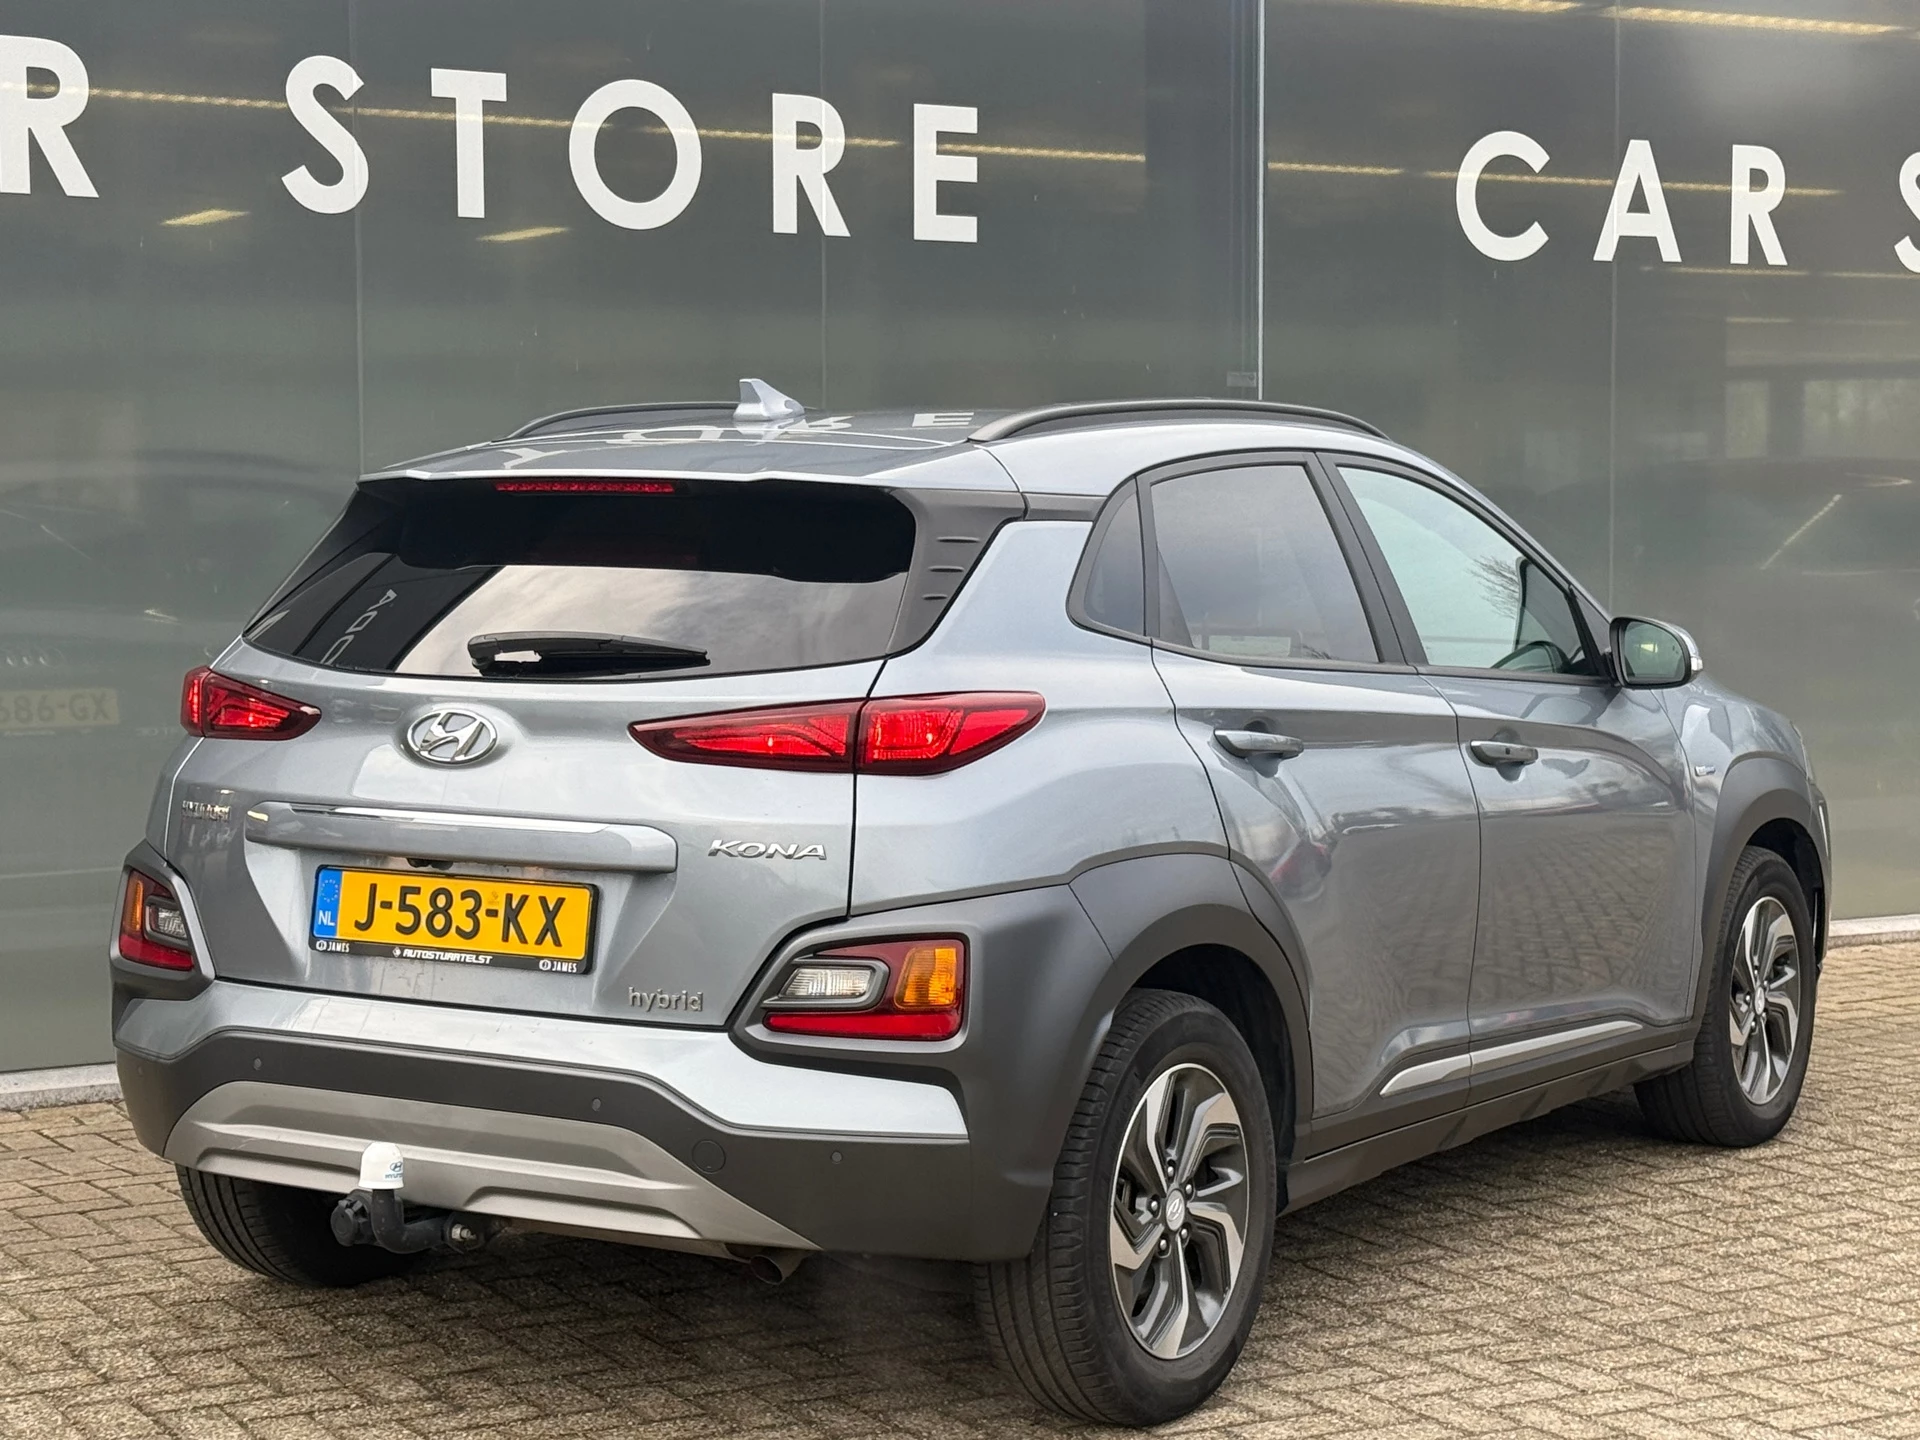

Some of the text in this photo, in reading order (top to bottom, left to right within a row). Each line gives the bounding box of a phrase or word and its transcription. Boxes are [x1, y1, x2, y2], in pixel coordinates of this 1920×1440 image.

[281, 54, 978, 244] STORE
[1456, 130, 1788, 267] CAR
[708, 839, 827, 860] KONA
[318, 883, 566, 948] NL J-583-KX
[327, 941, 350, 953] JAMES
[552, 961, 578, 973] JAMES
[628, 986, 704, 1013] hybrid
